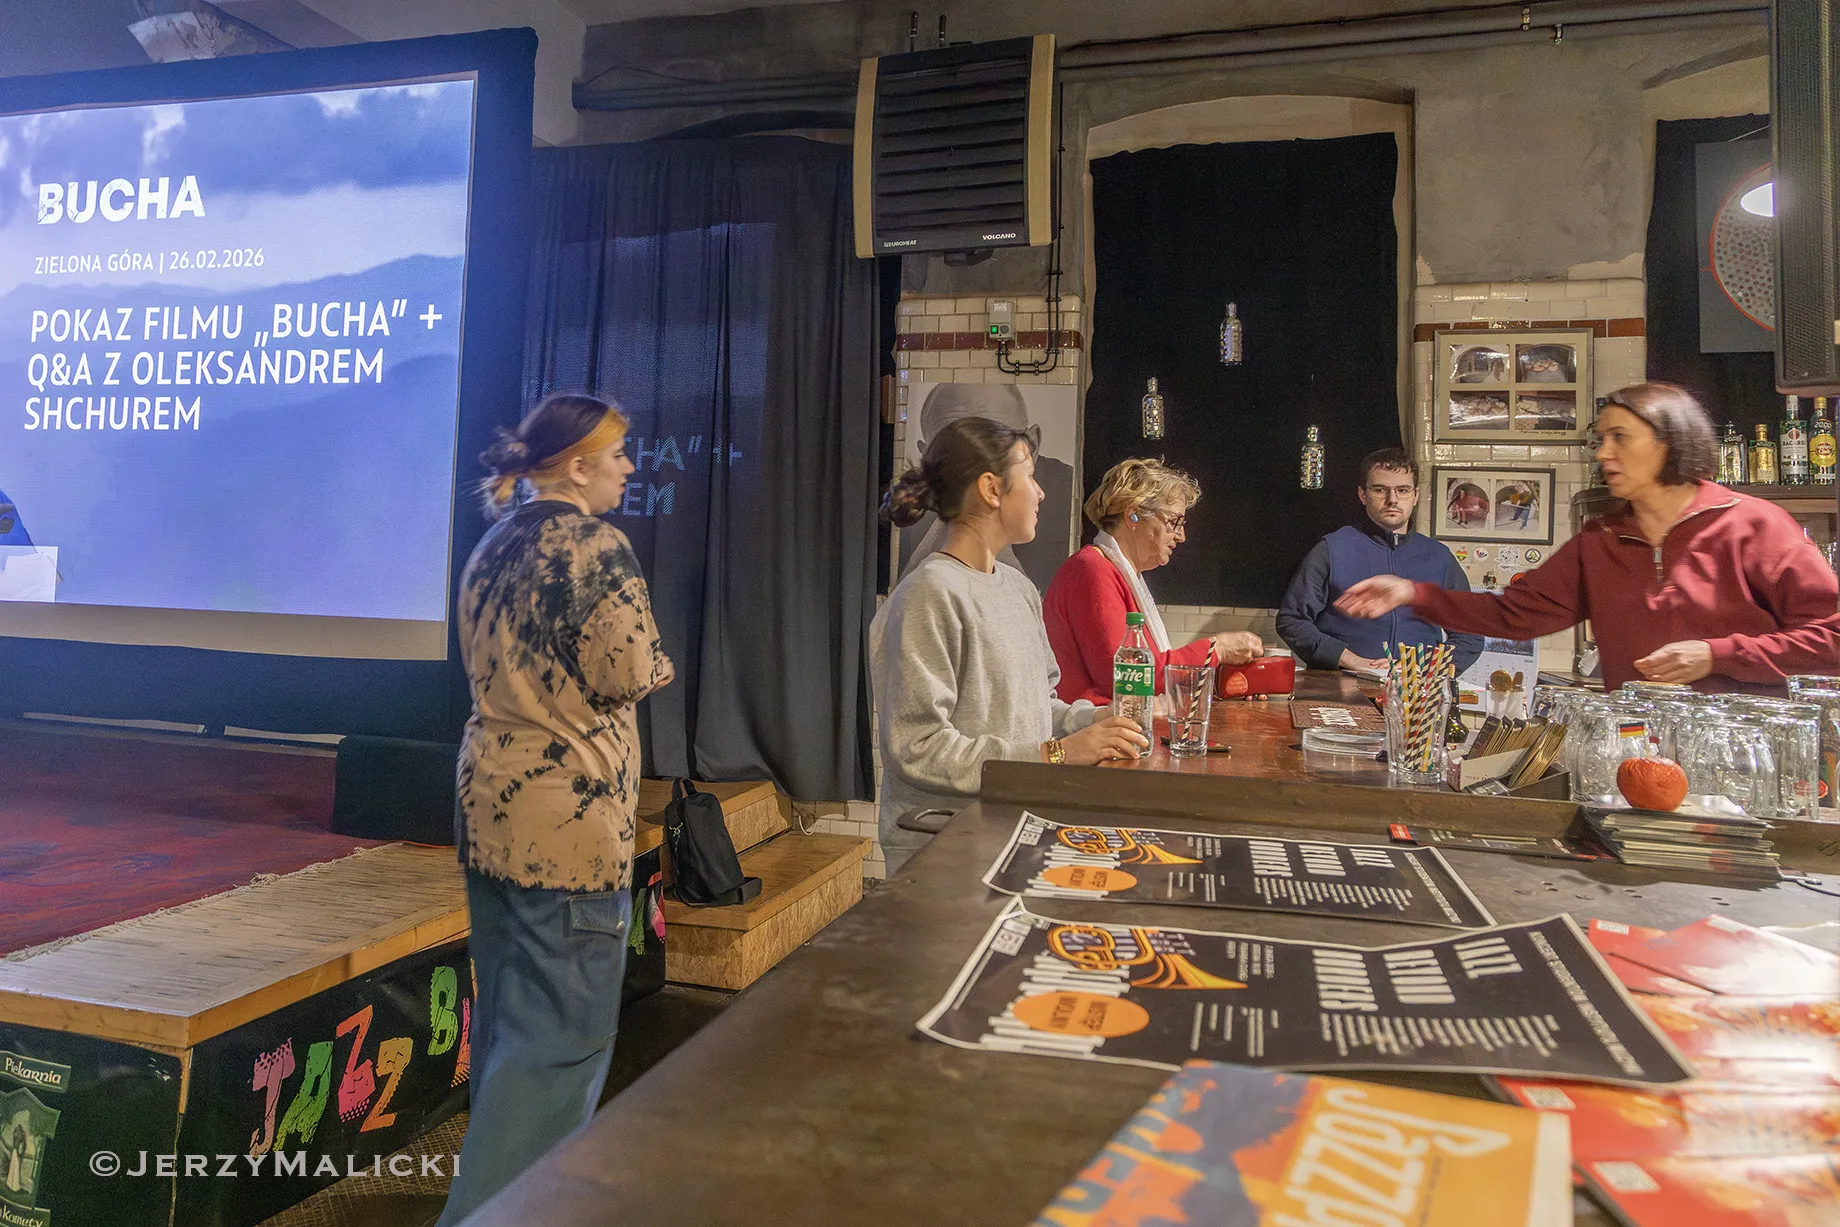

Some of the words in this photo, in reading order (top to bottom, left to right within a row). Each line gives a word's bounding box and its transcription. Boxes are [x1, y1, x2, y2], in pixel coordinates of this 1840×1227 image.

[37, 175, 206, 225] BUCHA
[983, 233, 1016, 241] VOLCANO
[34, 254, 102, 275] ZIELONA
[107, 249, 154, 272] GÓRA
[169, 248, 265, 270] 26.02.2026
[30, 307, 132, 343] POKAZ
[143, 304, 243, 341] FILMU
[27, 352, 93, 392] Q&A
[104, 353, 122, 386] Z
[131, 348, 384, 386] OLEKSANDREM
[24, 396, 201, 431] SHCHUREM
[1382, 948, 1457, 1005] BEYOND
[1452, 936, 1524, 980] JAZZ
[1312, 949, 1380, 1013] BORDERS
[5, 1057, 62, 1085] Piekarnia
[250, 1003, 414, 1159] JAZZ
